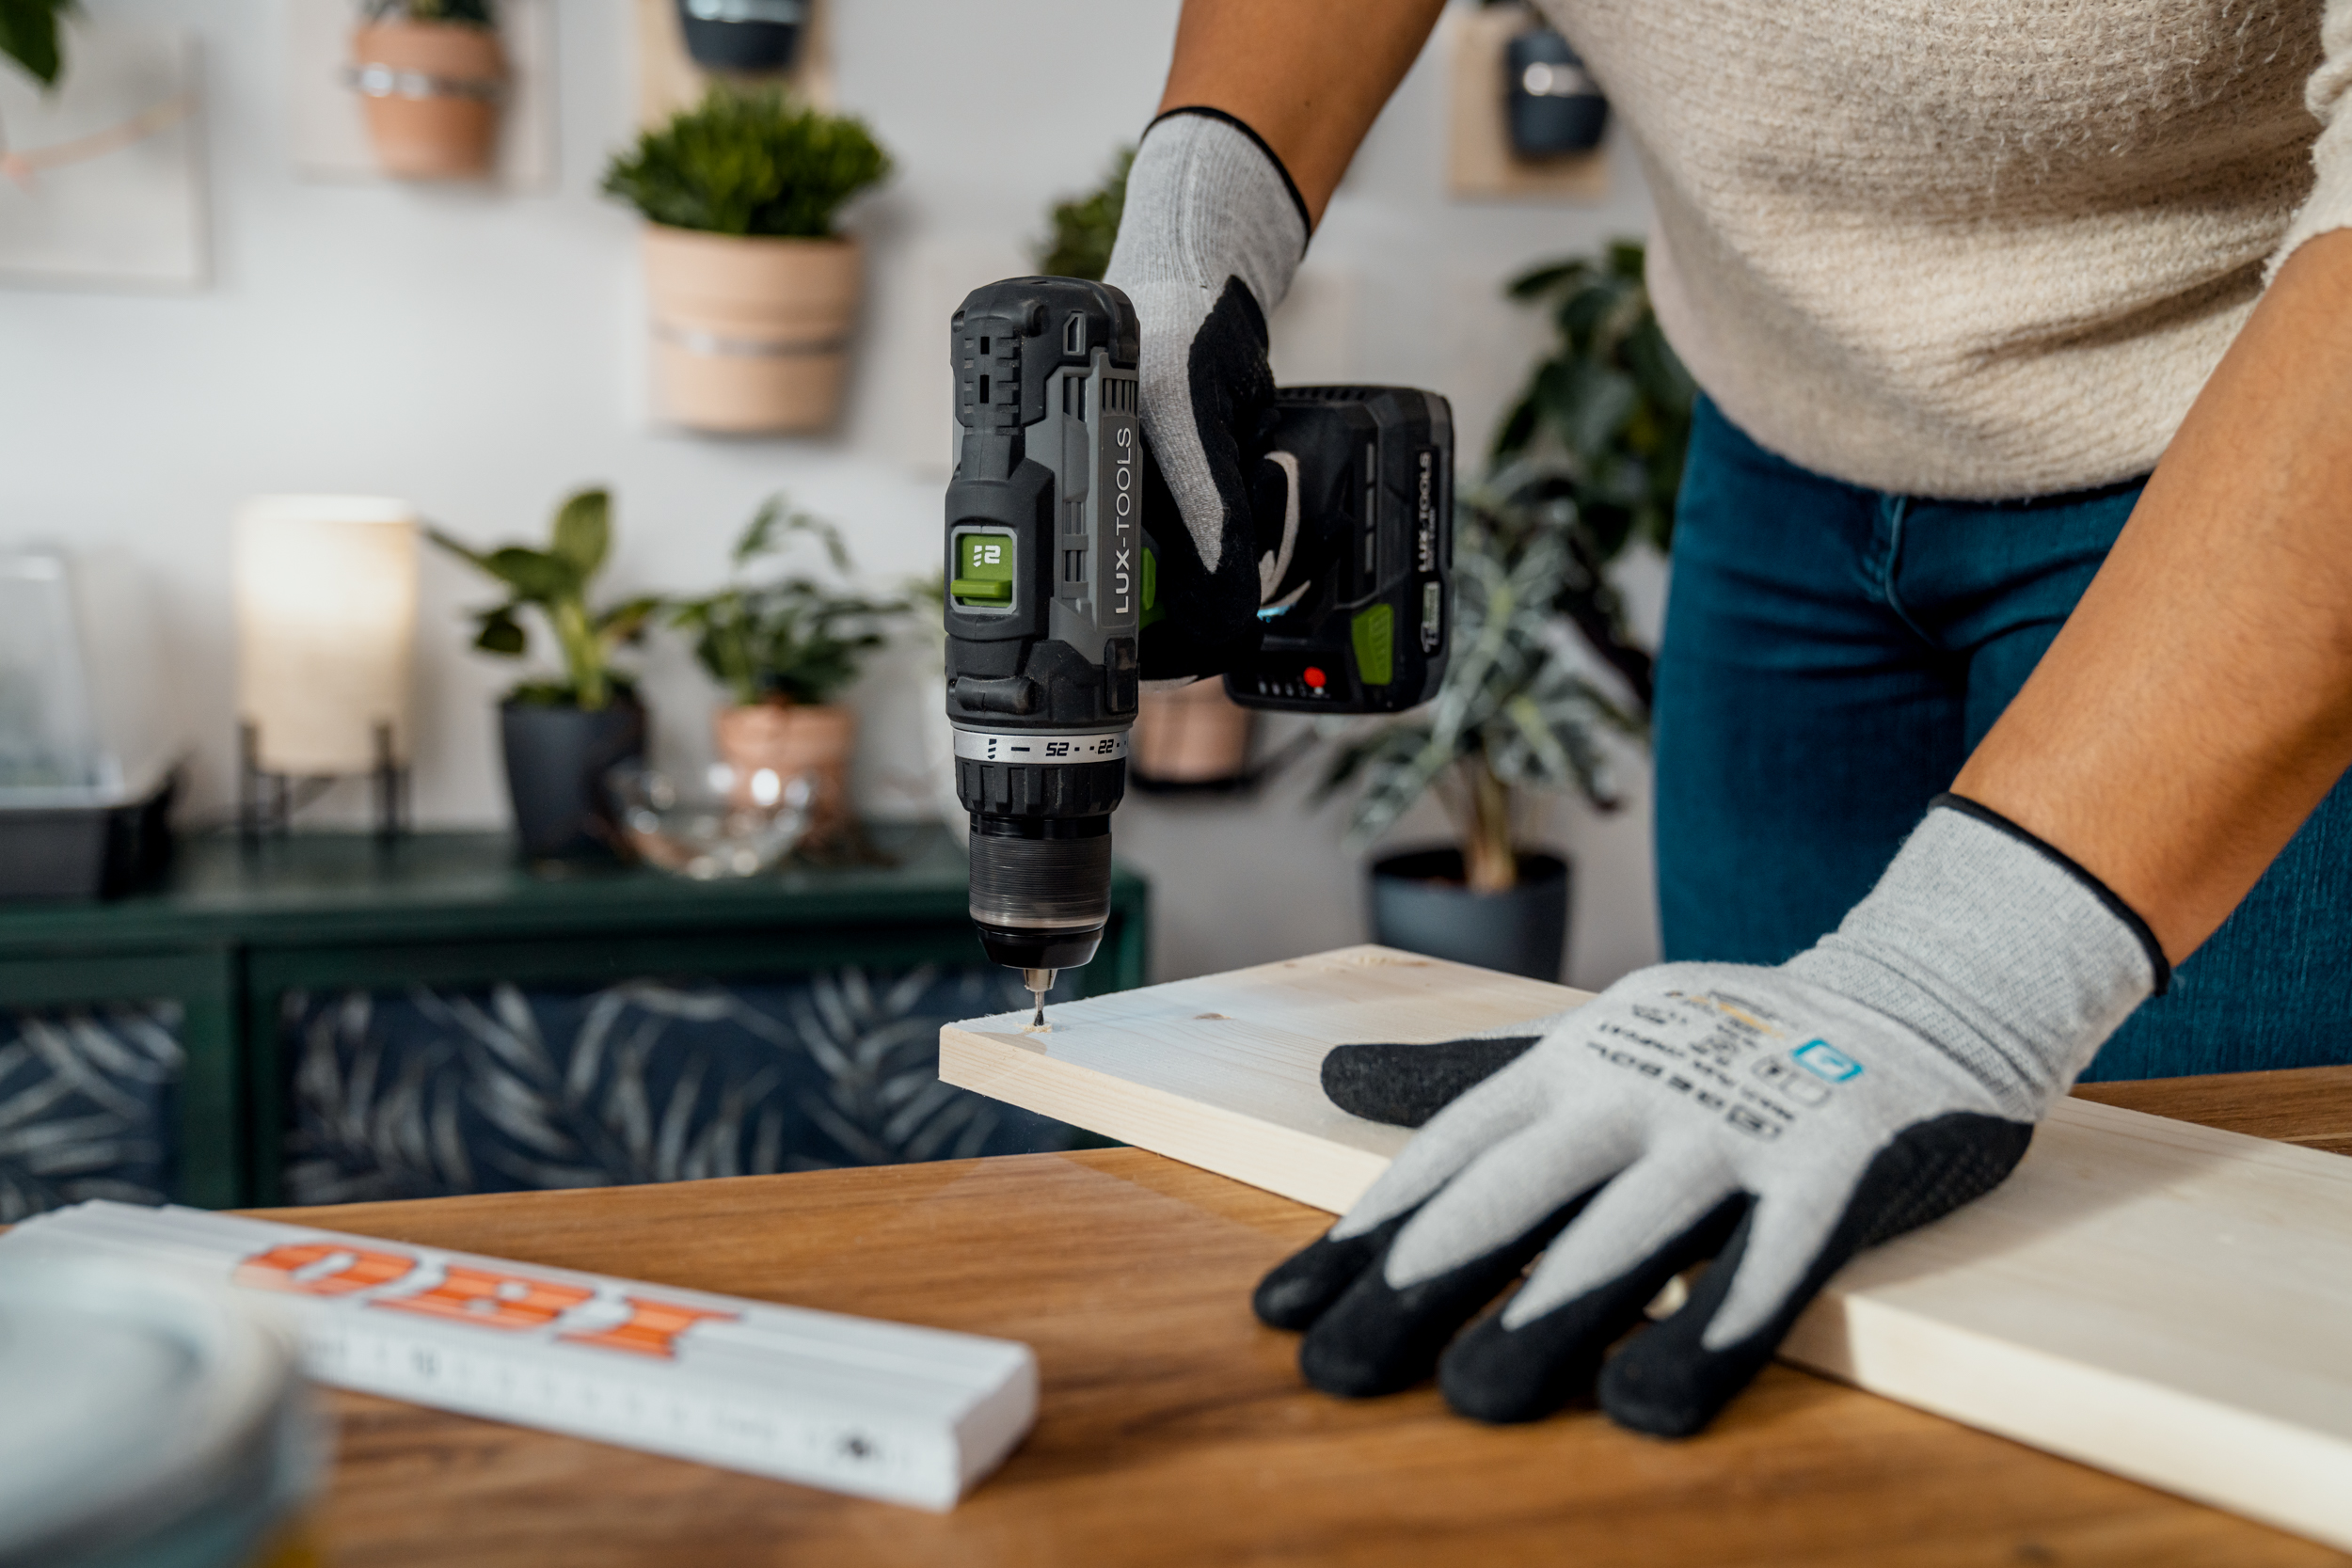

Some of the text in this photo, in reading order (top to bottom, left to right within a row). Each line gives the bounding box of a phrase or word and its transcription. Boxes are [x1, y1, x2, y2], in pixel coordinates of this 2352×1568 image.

[1115, 427, 1132, 614] LUX-TOOLS
[1418, 451, 1433, 573] LUX-TOOLS
[1098, 738, 1115, 754] 22
[233, 1242, 747, 1360] OBI
